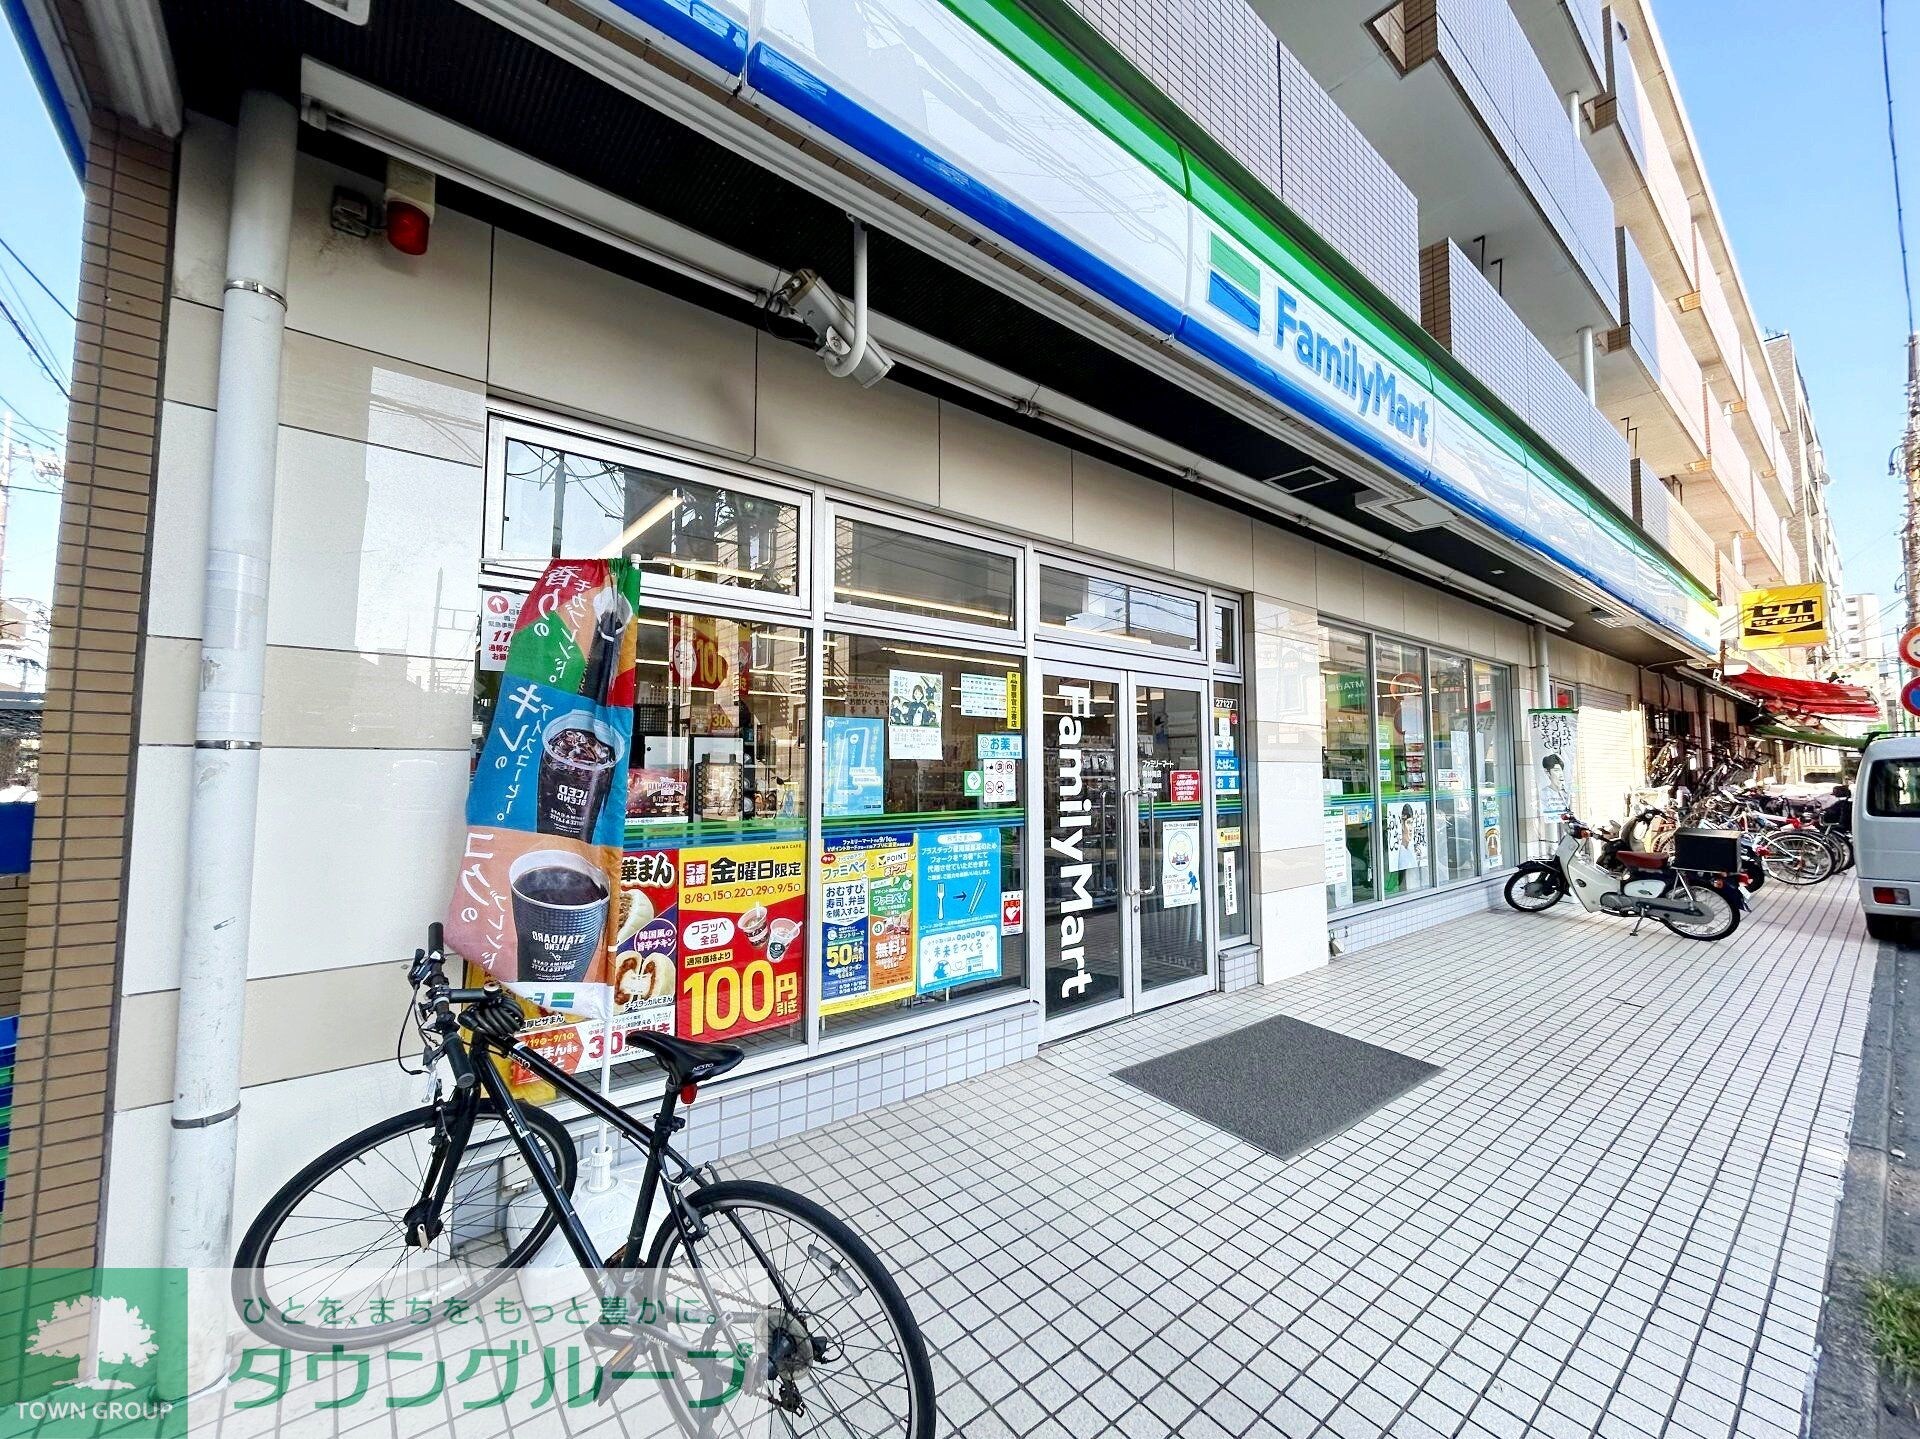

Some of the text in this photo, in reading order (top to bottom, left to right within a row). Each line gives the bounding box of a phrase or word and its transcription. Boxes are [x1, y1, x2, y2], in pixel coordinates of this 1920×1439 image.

[1274, 285, 1429, 448] FamilyMart
[1748, 599, 1817, 618] セオ
[1753, 614, 1814, 627] サイクル
[990, 737, 1011, 751] お薬
[1142, 760, 1175, 768] ファミリーマート
[1216, 759, 1235, 769] たばこ
[1050, 684, 1094, 999] FamilyMart
[711, 857, 801, 885] 金曜日限定
[823, 860, 867, 880] ファミペイ
[692, 919, 727, 934] フラッペ
[700, 934, 719, 945] 全品
[686, 953, 731, 966] 通常価格より
[522, 1016, 565, 1029] 厚ピザまん
